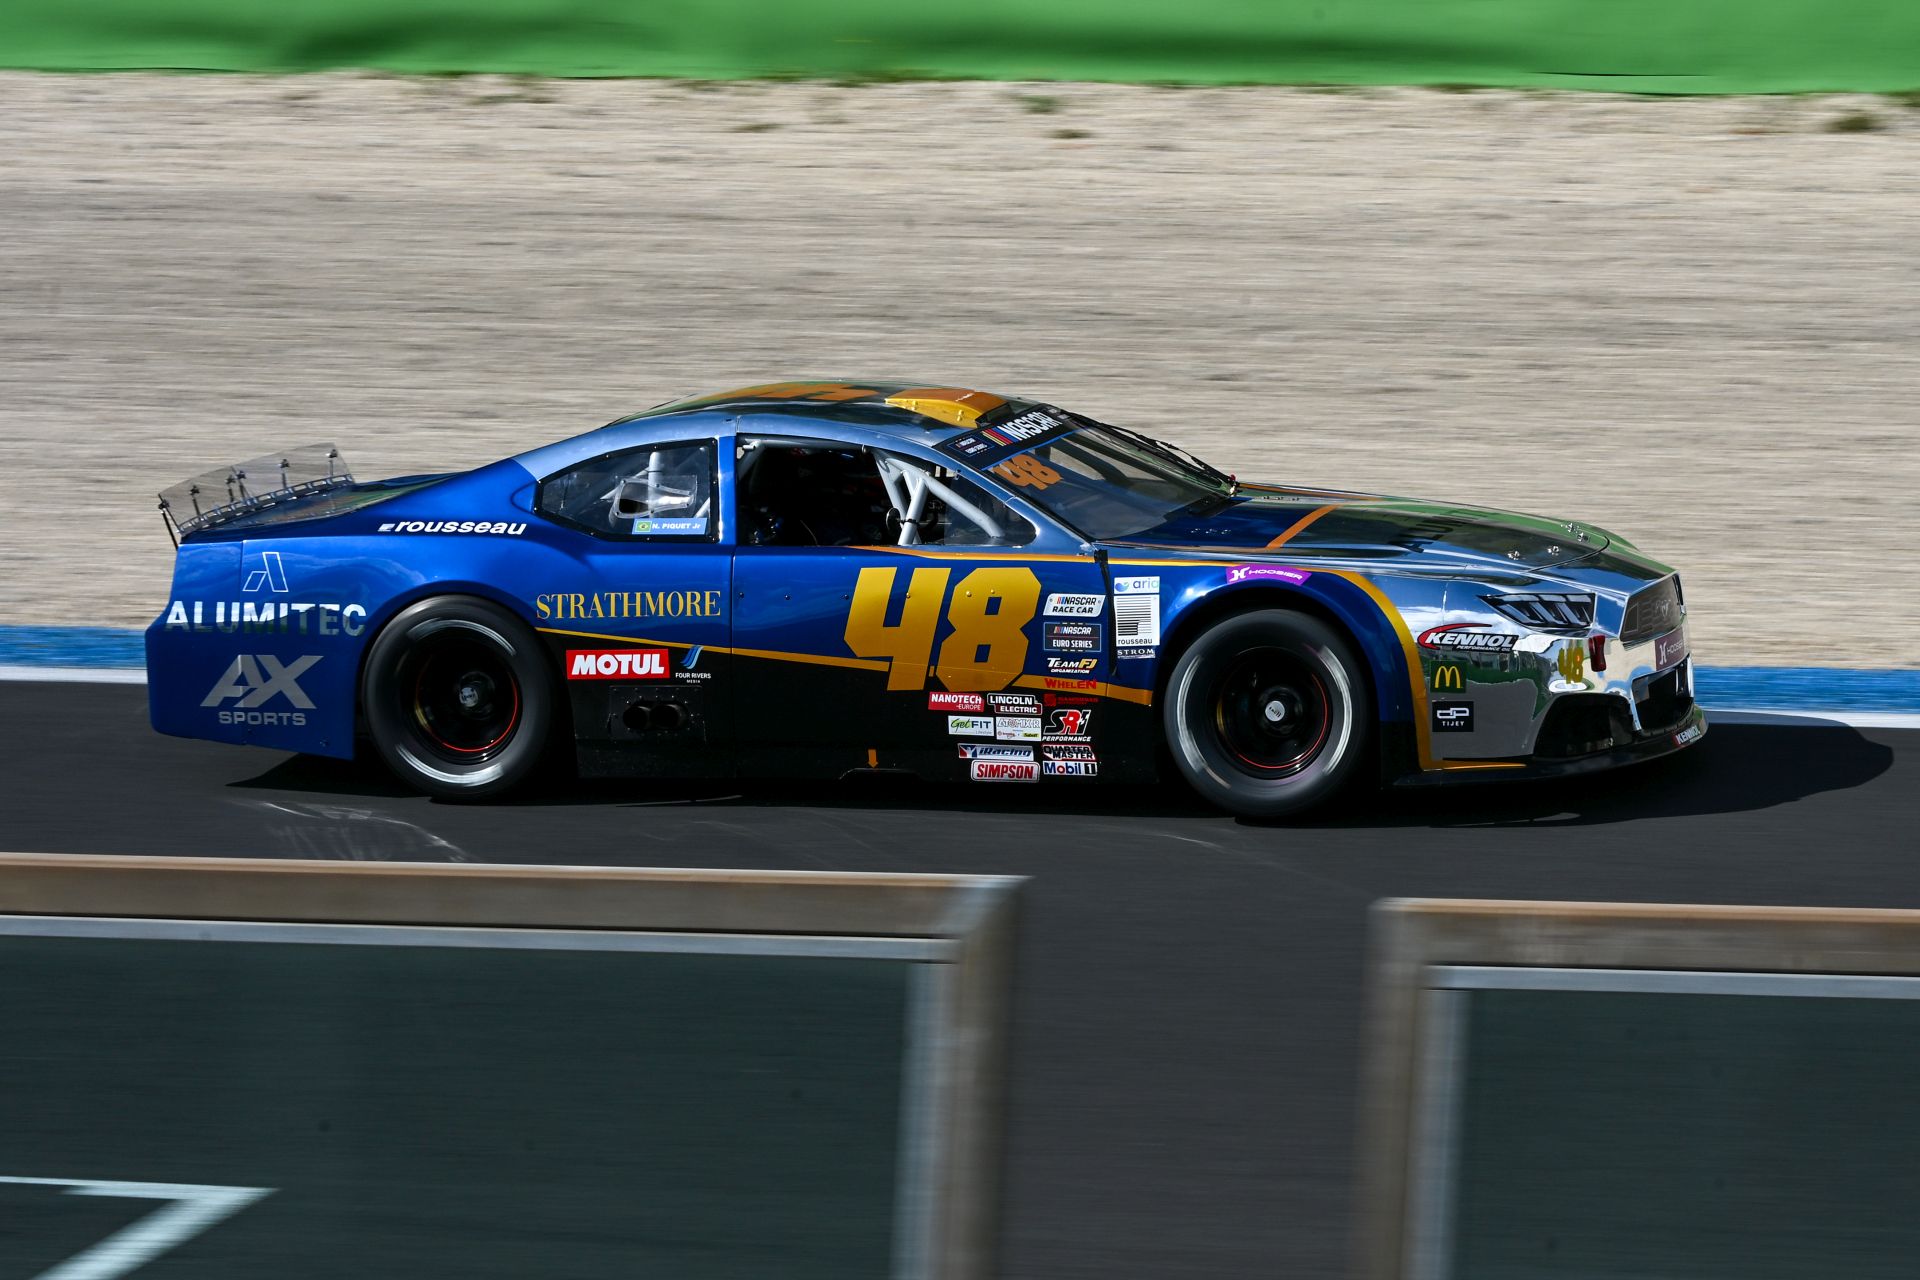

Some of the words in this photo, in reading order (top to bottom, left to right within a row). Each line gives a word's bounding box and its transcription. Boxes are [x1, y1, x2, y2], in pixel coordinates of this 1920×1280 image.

[996, 411, 1063, 441] NASCAR
[394, 520, 527, 536] rousseau
[652, 522, 660, 530] N.
[662, 522, 691, 530] PIQUET
[1248, 569, 1303, 580] HOOSIER
[1132, 578, 1159, 589] aria
[536, 590, 721, 620] STRATHMORE
[1063, 596, 1097, 606] NASCAR
[1052, 606, 1074, 614] RACE
[1076, 606, 1094, 614] CAR
[163, 600, 367, 637] ALUMITEC
[844, 566, 1042, 692] 48
[1062, 626, 1092, 635] NASCAR
[1053, 639, 1070, 648] EURO
[1071, 640, 1093, 648] SERIES
[1425, 632, 1514, 648] KENNOL
[571, 653, 665, 676] MOTUL
[1558, 647, 1584, 684] 48
[200, 654, 324, 709] AX
[931, 693, 982, 704] NANOTECH
[990, 695, 1033, 705] LINCOLN
[1000, 705, 1038, 713] ELECTRIC
[218, 711, 307, 726] SPORTS
[1043, 709, 1091, 735] SRI
[979, 747, 1032, 758] iRacing
[1043, 745, 1090, 754] QUARTER
[1052, 751, 1093, 760] MASTER
[977, 763, 1034, 779] SIMPSON
[1044, 762, 1081, 774] Mobil
